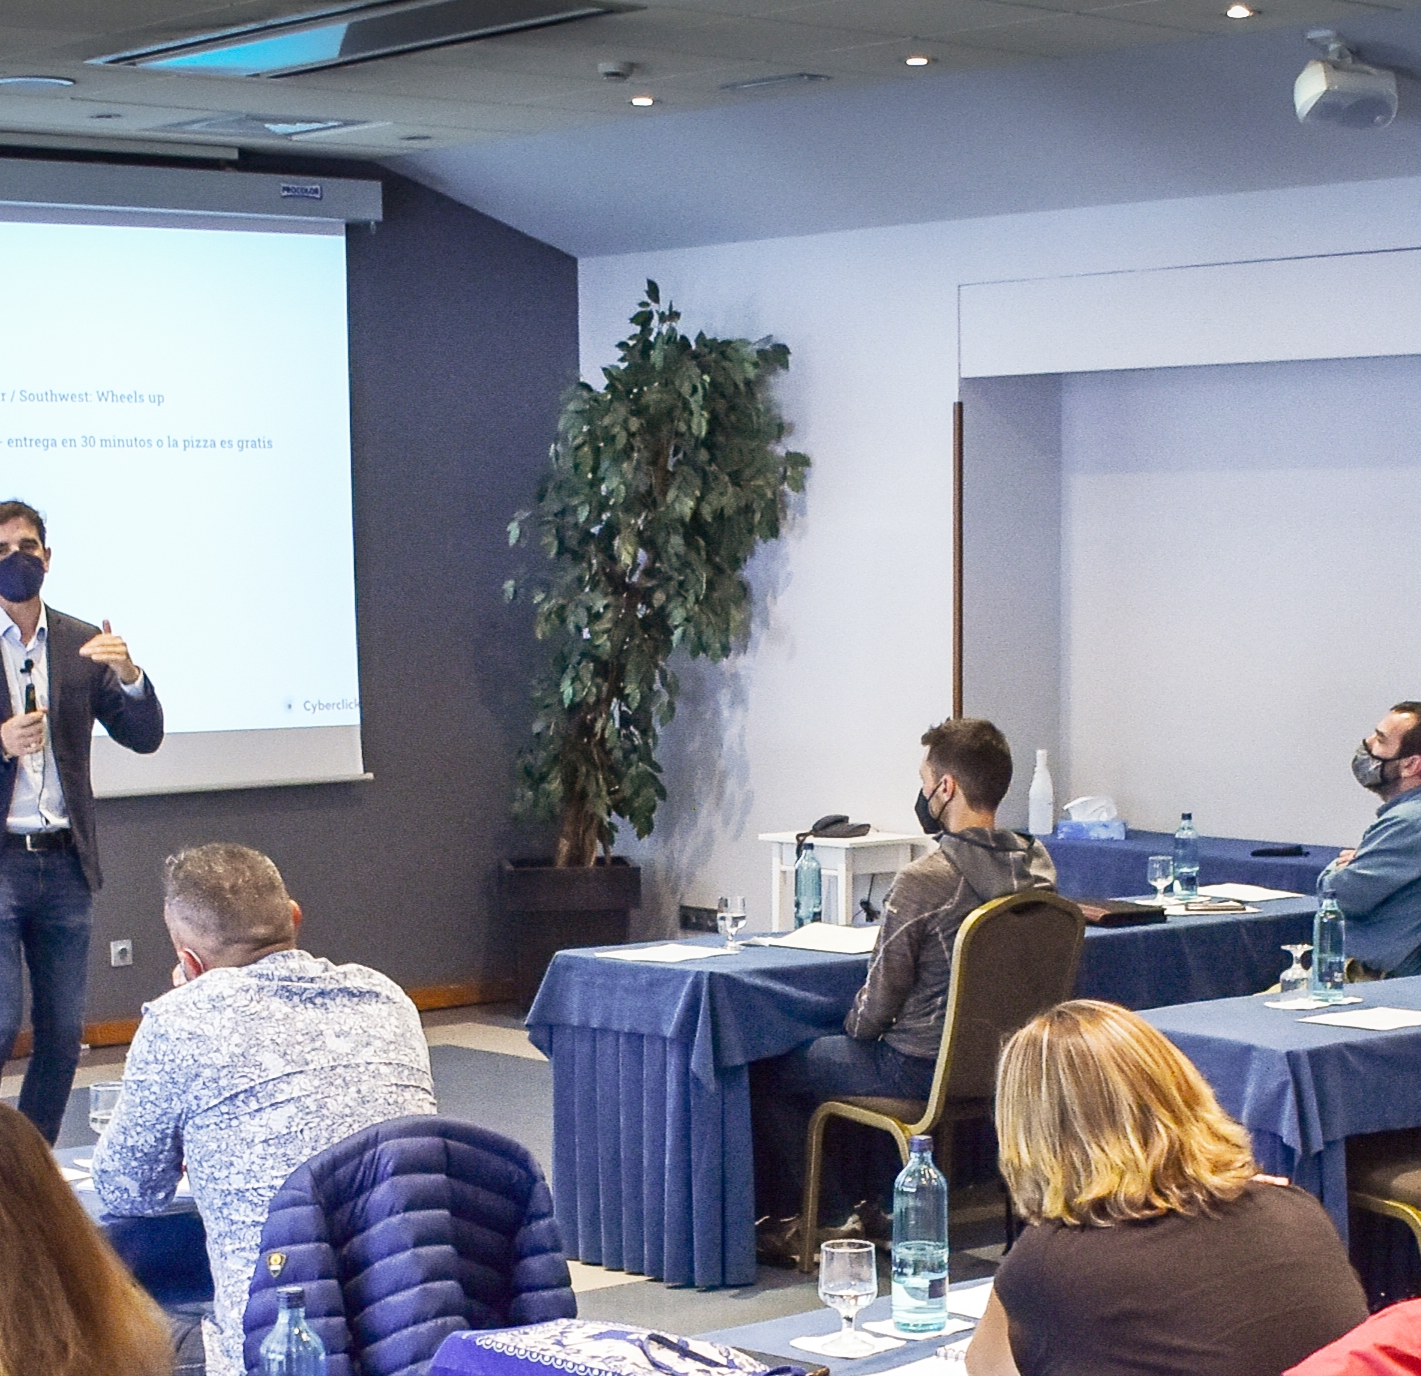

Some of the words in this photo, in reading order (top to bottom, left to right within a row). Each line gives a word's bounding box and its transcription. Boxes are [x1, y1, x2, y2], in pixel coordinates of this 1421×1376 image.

[9, 389, 16, 403] /
[19, 388, 93, 403] Southwest:
[95, 389, 145, 404] Wheels
[147, 393, 165, 407] up
[6, 435, 58, 452] entrega
[60, 437, 78, 448] en
[80, 434, 97, 449] 30
[99, 434, 153, 449] minutos
[155, 438, 165, 449] o
[166, 434, 179, 449] la
[182, 435, 217, 452] pizza
[219, 438, 234, 449] es
[236, 435, 274, 453] gratis
